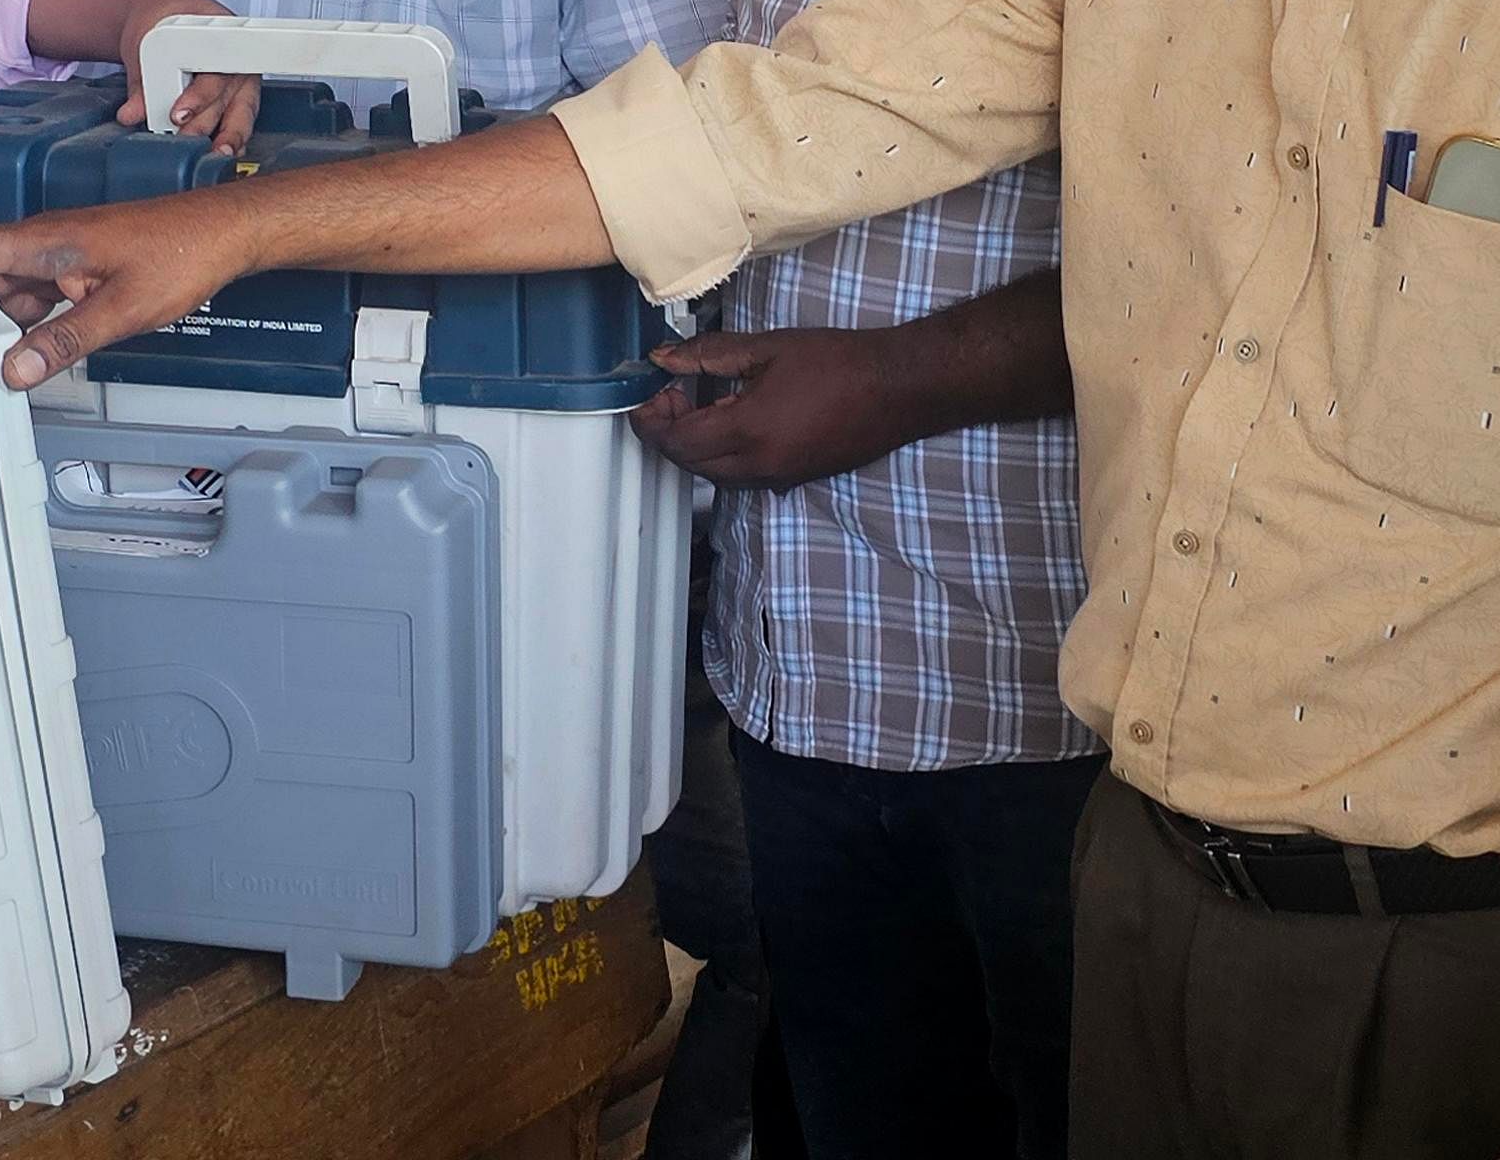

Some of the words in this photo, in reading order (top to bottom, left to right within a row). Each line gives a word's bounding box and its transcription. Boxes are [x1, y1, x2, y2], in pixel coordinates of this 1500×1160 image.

[184, 315, 248, 329] CORPORATION
[249, 319, 261, 329] OF
[262, 320, 287, 331] INDIA
[287, 321, 323, 333] LIMITED
